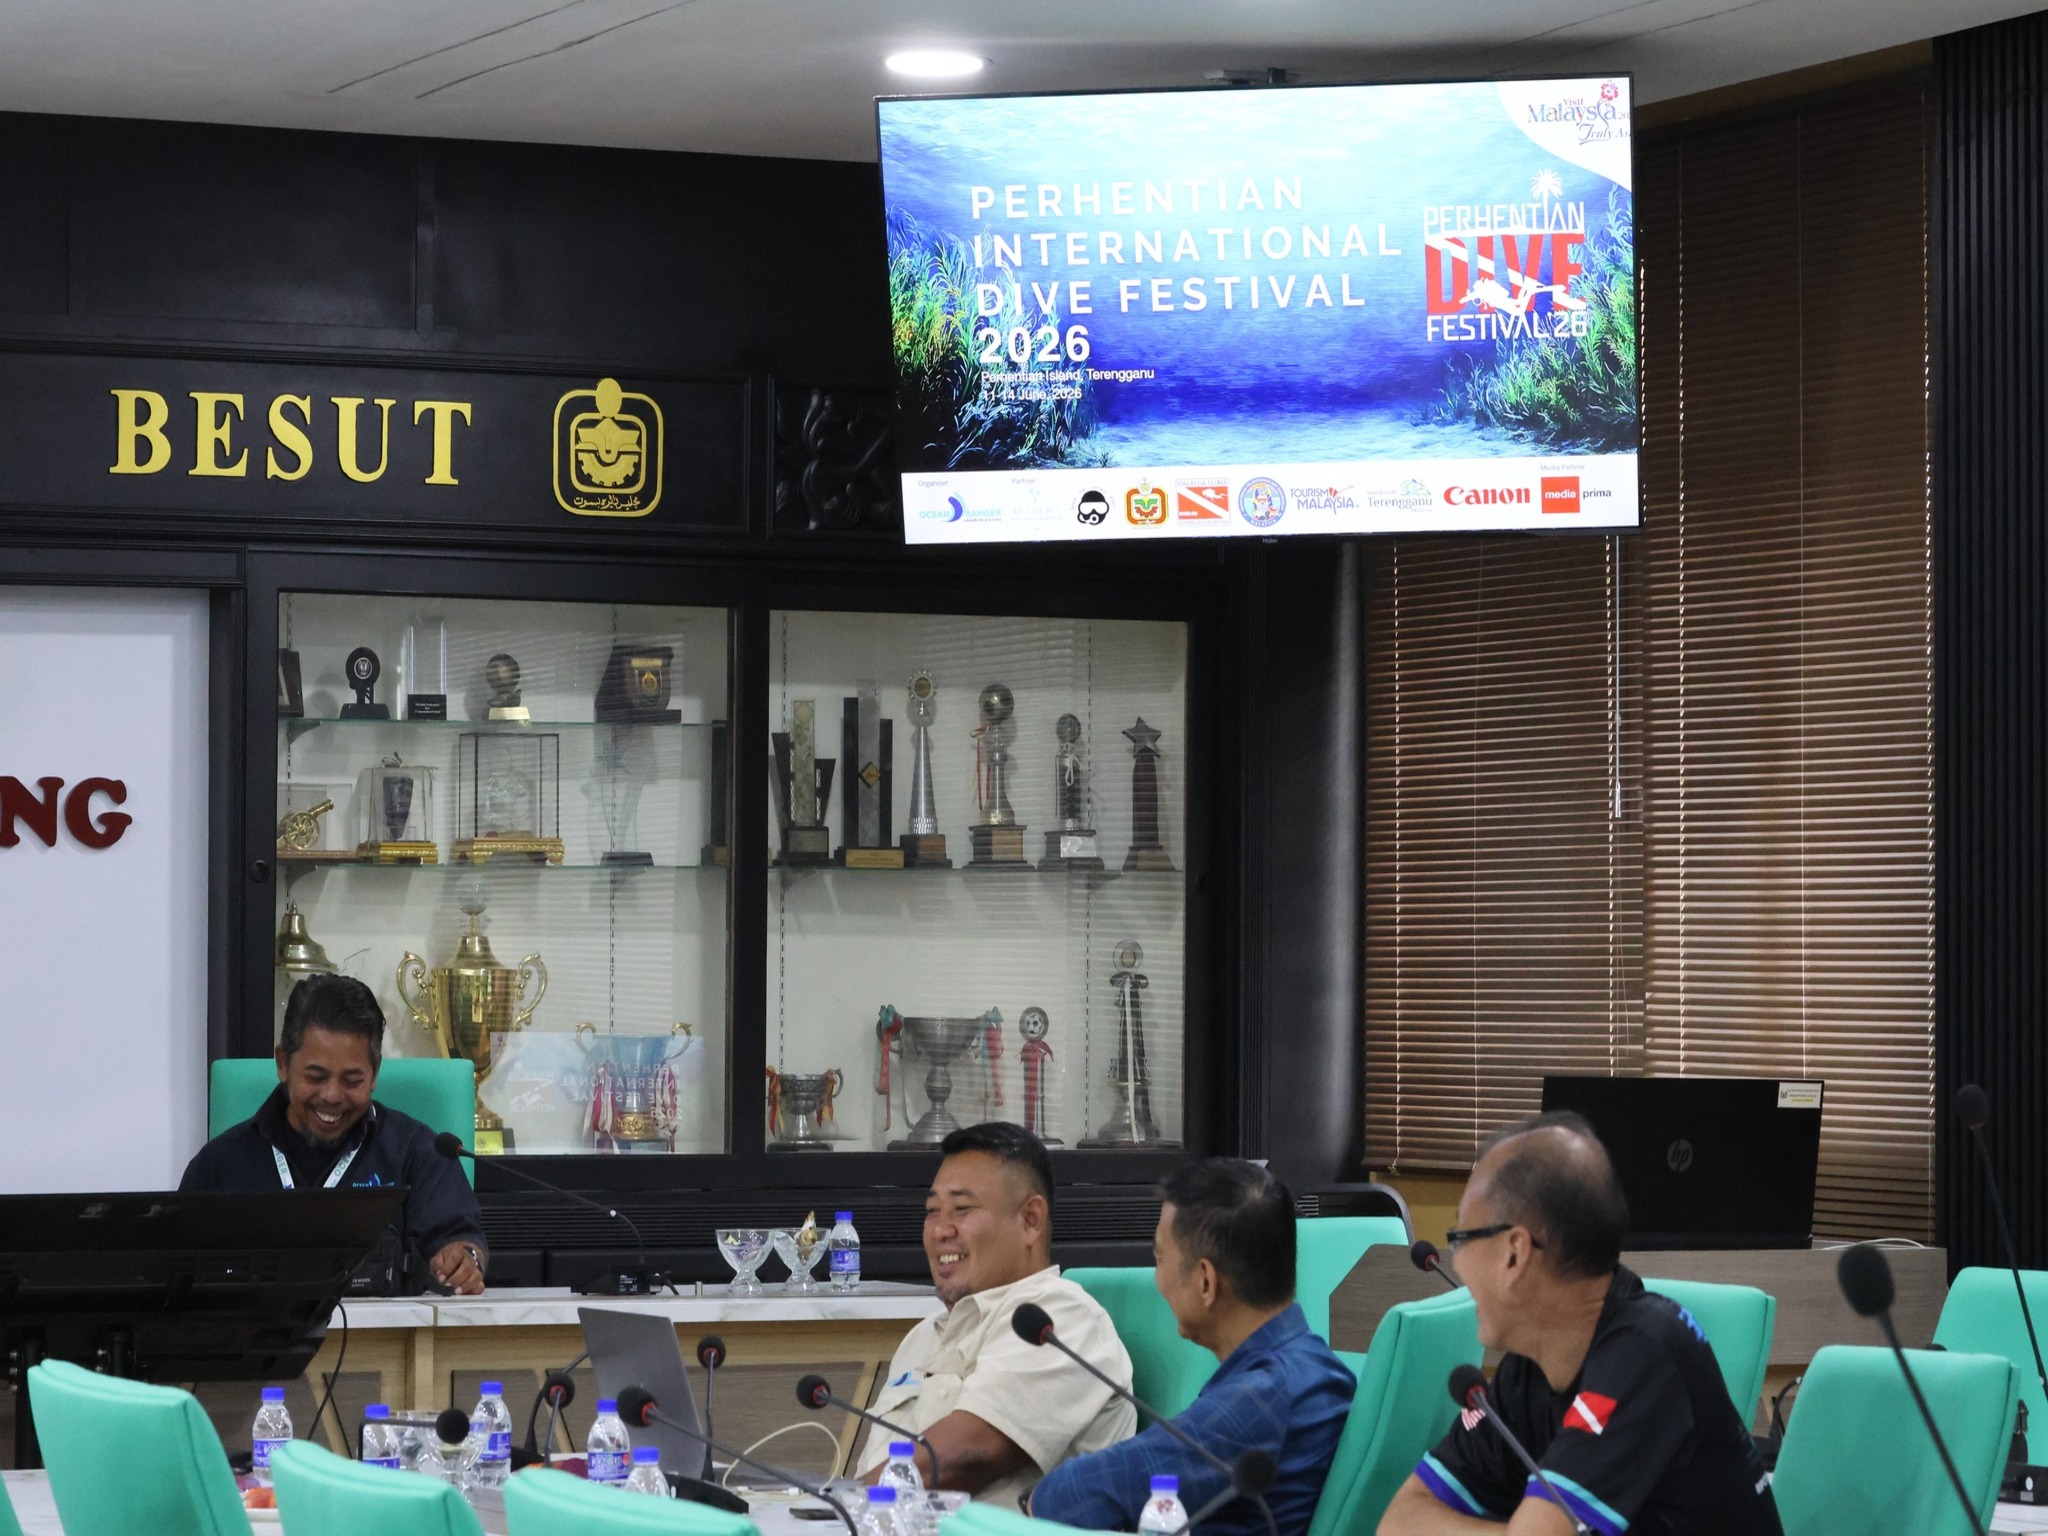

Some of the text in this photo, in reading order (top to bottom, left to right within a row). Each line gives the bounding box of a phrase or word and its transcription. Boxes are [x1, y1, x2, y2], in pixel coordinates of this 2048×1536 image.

[1563, 98, 1584, 106] Visit
[1528, 100, 1631, 126] Malaysia 20
[1579, 123, 1613, 141] Truly
[971, 176, 1303, 219] PERHENTIAN
[1424, 201, 1585, 236] PERHENTIAN
[974, 223, 1402, 268] INTERNATIONAL
[1425, 234, 1587, 315] DIVE
[976, 273, 1366, 317] DIVE FESTIVAL
[979, 325, 1090, 363] 2026
[981, 370, 1044, 383] Perhentian
[1086, 367, 1155, 383] Terengganu
[1052, 388, 1083, 400] 2026
[110, 389, 472, 485] BESUT
[1561, 463, 1585, 471] Partner
[1290, 488, 1329, 498] TOURISM
[1368, 496, 1432, 510] Terengganu
[1443, 485, 1530, 505] Canon
[1545, 488, 1612, 500] media prima
[919, 509, 1001, 519] OCEAN RANGER
[1297, 496, 1355, 514] MALAYSIA
[0, 775, 133, 850] NG
[1668, 1139, 1692, 1171] hp
